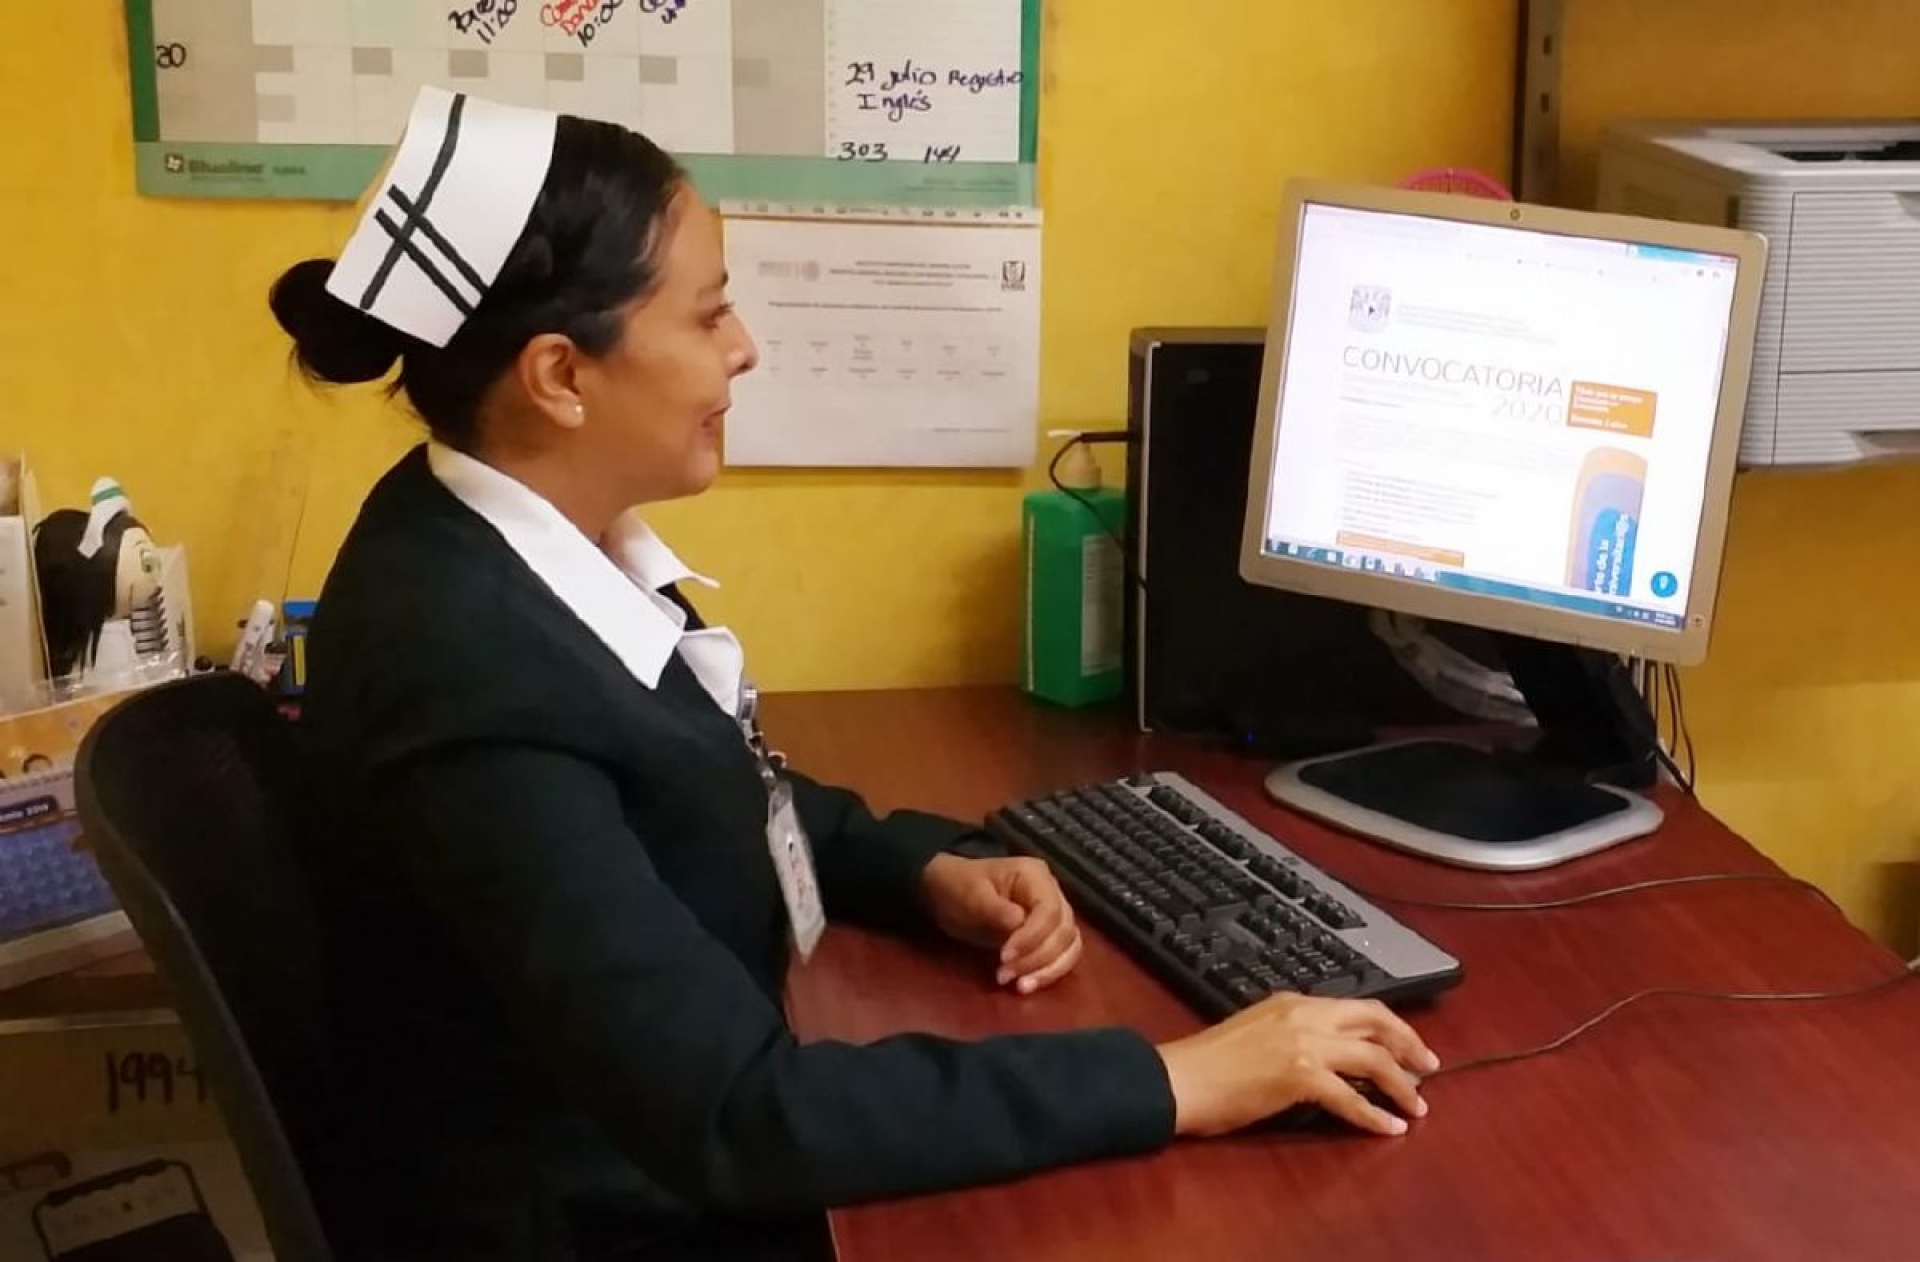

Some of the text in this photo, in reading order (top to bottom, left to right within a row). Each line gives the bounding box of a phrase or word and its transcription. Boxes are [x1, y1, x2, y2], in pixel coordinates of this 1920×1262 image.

[845, 61, 875, 86] 29
[880, 59, 937, 91] julio
[838, 141, 888, 162] 303
[1342, 344, 1564, 398] CONVOCATORIA
[1490, 395, 1565, 424] 2020
[106, 1051, 206, 1114] 1994
